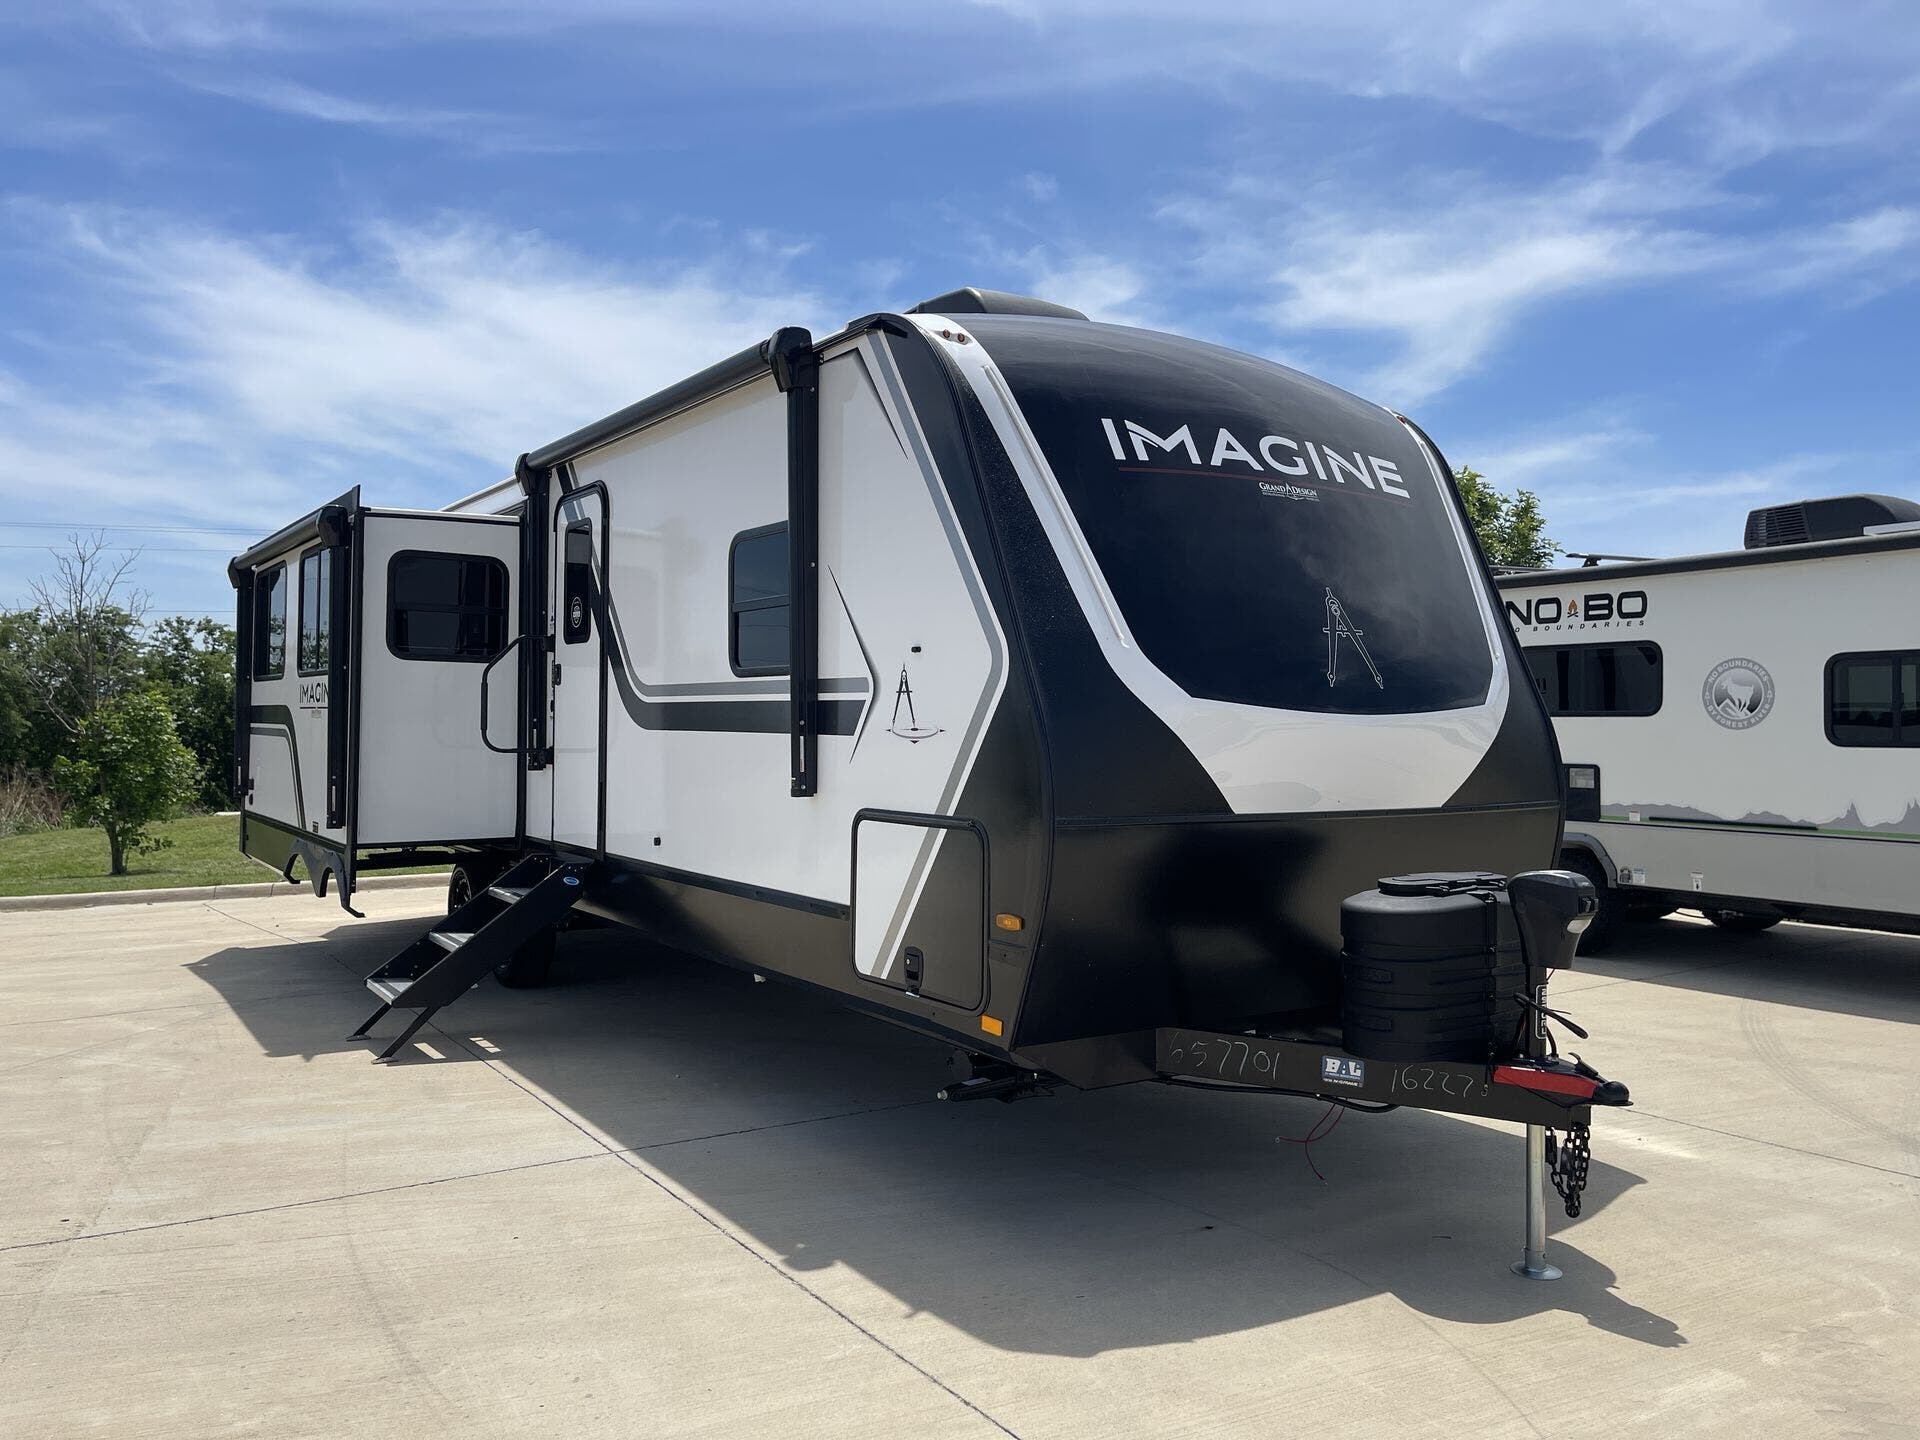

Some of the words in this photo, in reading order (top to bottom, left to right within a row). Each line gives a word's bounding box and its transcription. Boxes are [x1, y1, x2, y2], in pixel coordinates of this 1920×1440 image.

[1101, 418, 1411, 499] IMAGINE
[1258, 481, 1286, 493] GRAND
[1290, 485, 1318, 497] DESIGN
[1583, 590, 1648, 622] BO
[1533, 620, 1645, 633] BOUNDARIES
[1707, 671, 1719, 683] NO
[1717, 660, 1769, 682] BOUNDARIES
[299, 682, 329, 704] IMAGIN
[1716, 714, 1749, 728] FOREST
[1750, 703, 1771, 724] RIVER
[1168, 1031, 1281, 1081] 657701
